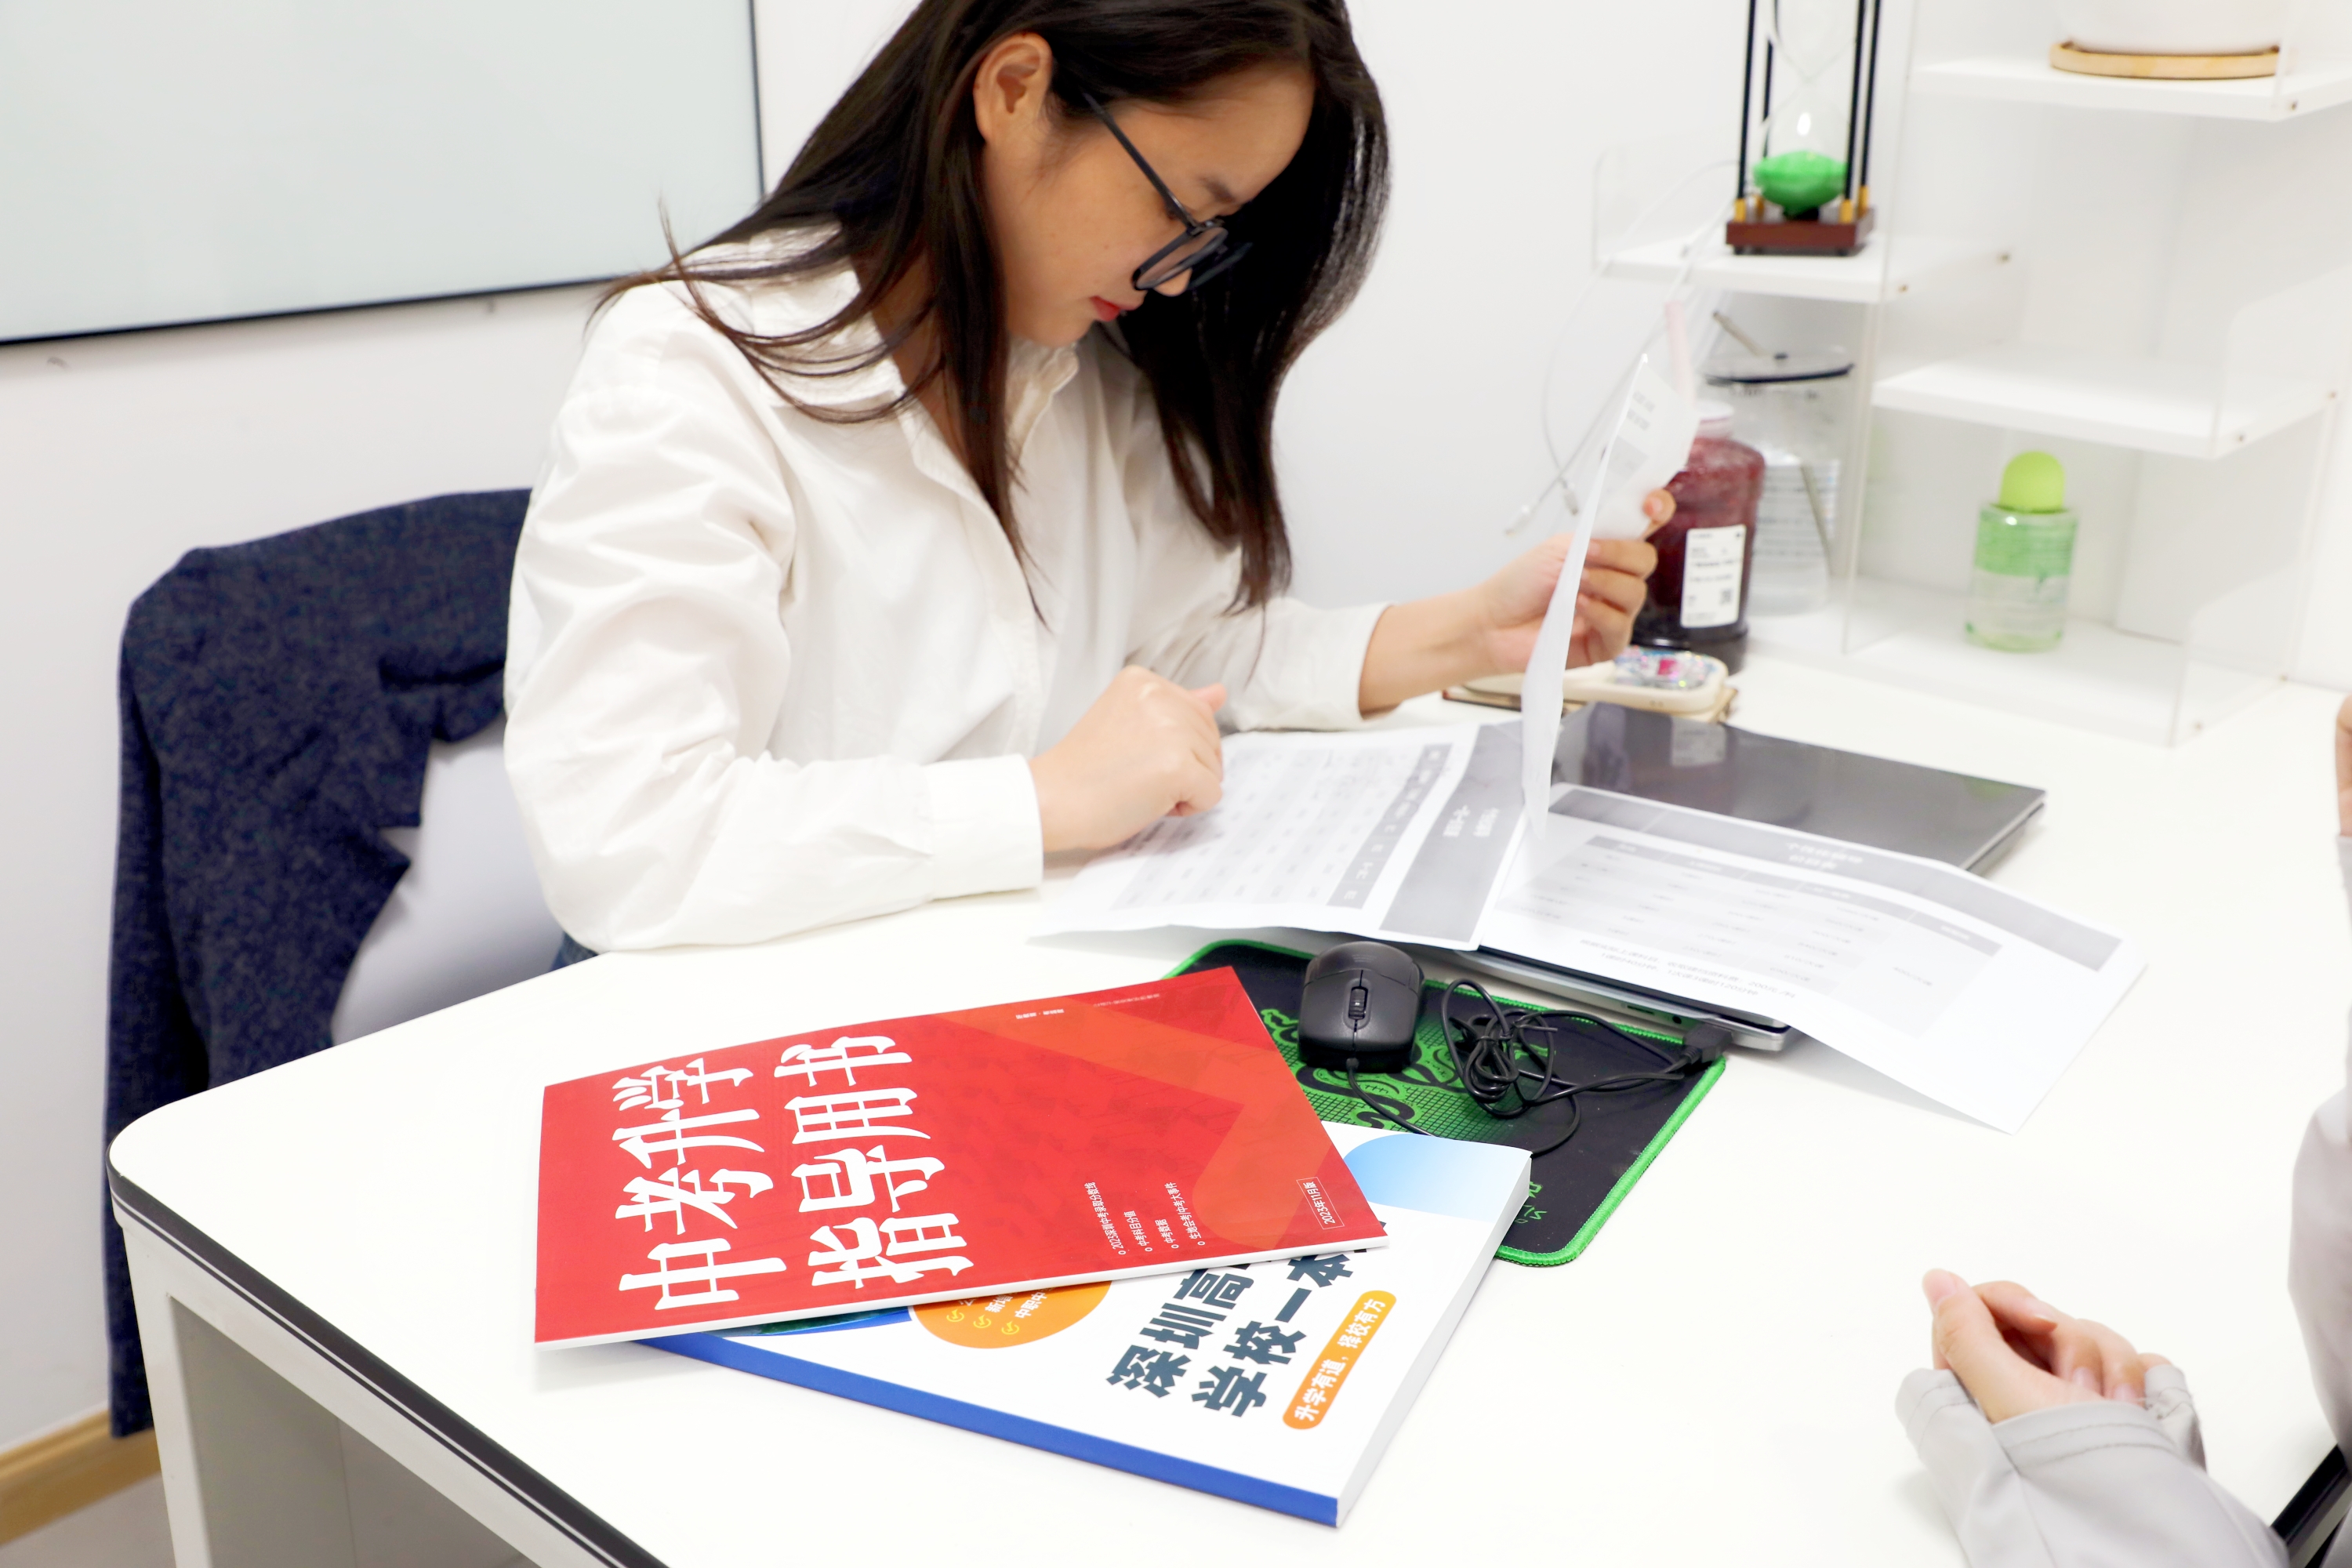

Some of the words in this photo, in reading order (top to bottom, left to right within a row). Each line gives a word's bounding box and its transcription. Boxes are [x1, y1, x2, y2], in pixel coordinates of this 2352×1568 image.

[612, 1058, 786, 1310] 中考升学
[774, 1036, 974, 1289] 指导用书
[1083, 1181, 1124, 1250] 2023深圳中考录取分数线
[1123, 1210, 1150, 1247] 中考科目分值
[1154, 1219, 1175, 1244] 中考数据
[1303, 1181, 1336, 1225] 2023年11月版
[985, 1293, 1014, 1313] 新增
[1014, 1288, 1051, 1319] 中职中
[1106, 1262, 1254, 1398] 深圳高
[1191, 1248, 1367, 1417] 学校一本
[1294, 1298, 1385, 1422] 升学有道，择校有方
